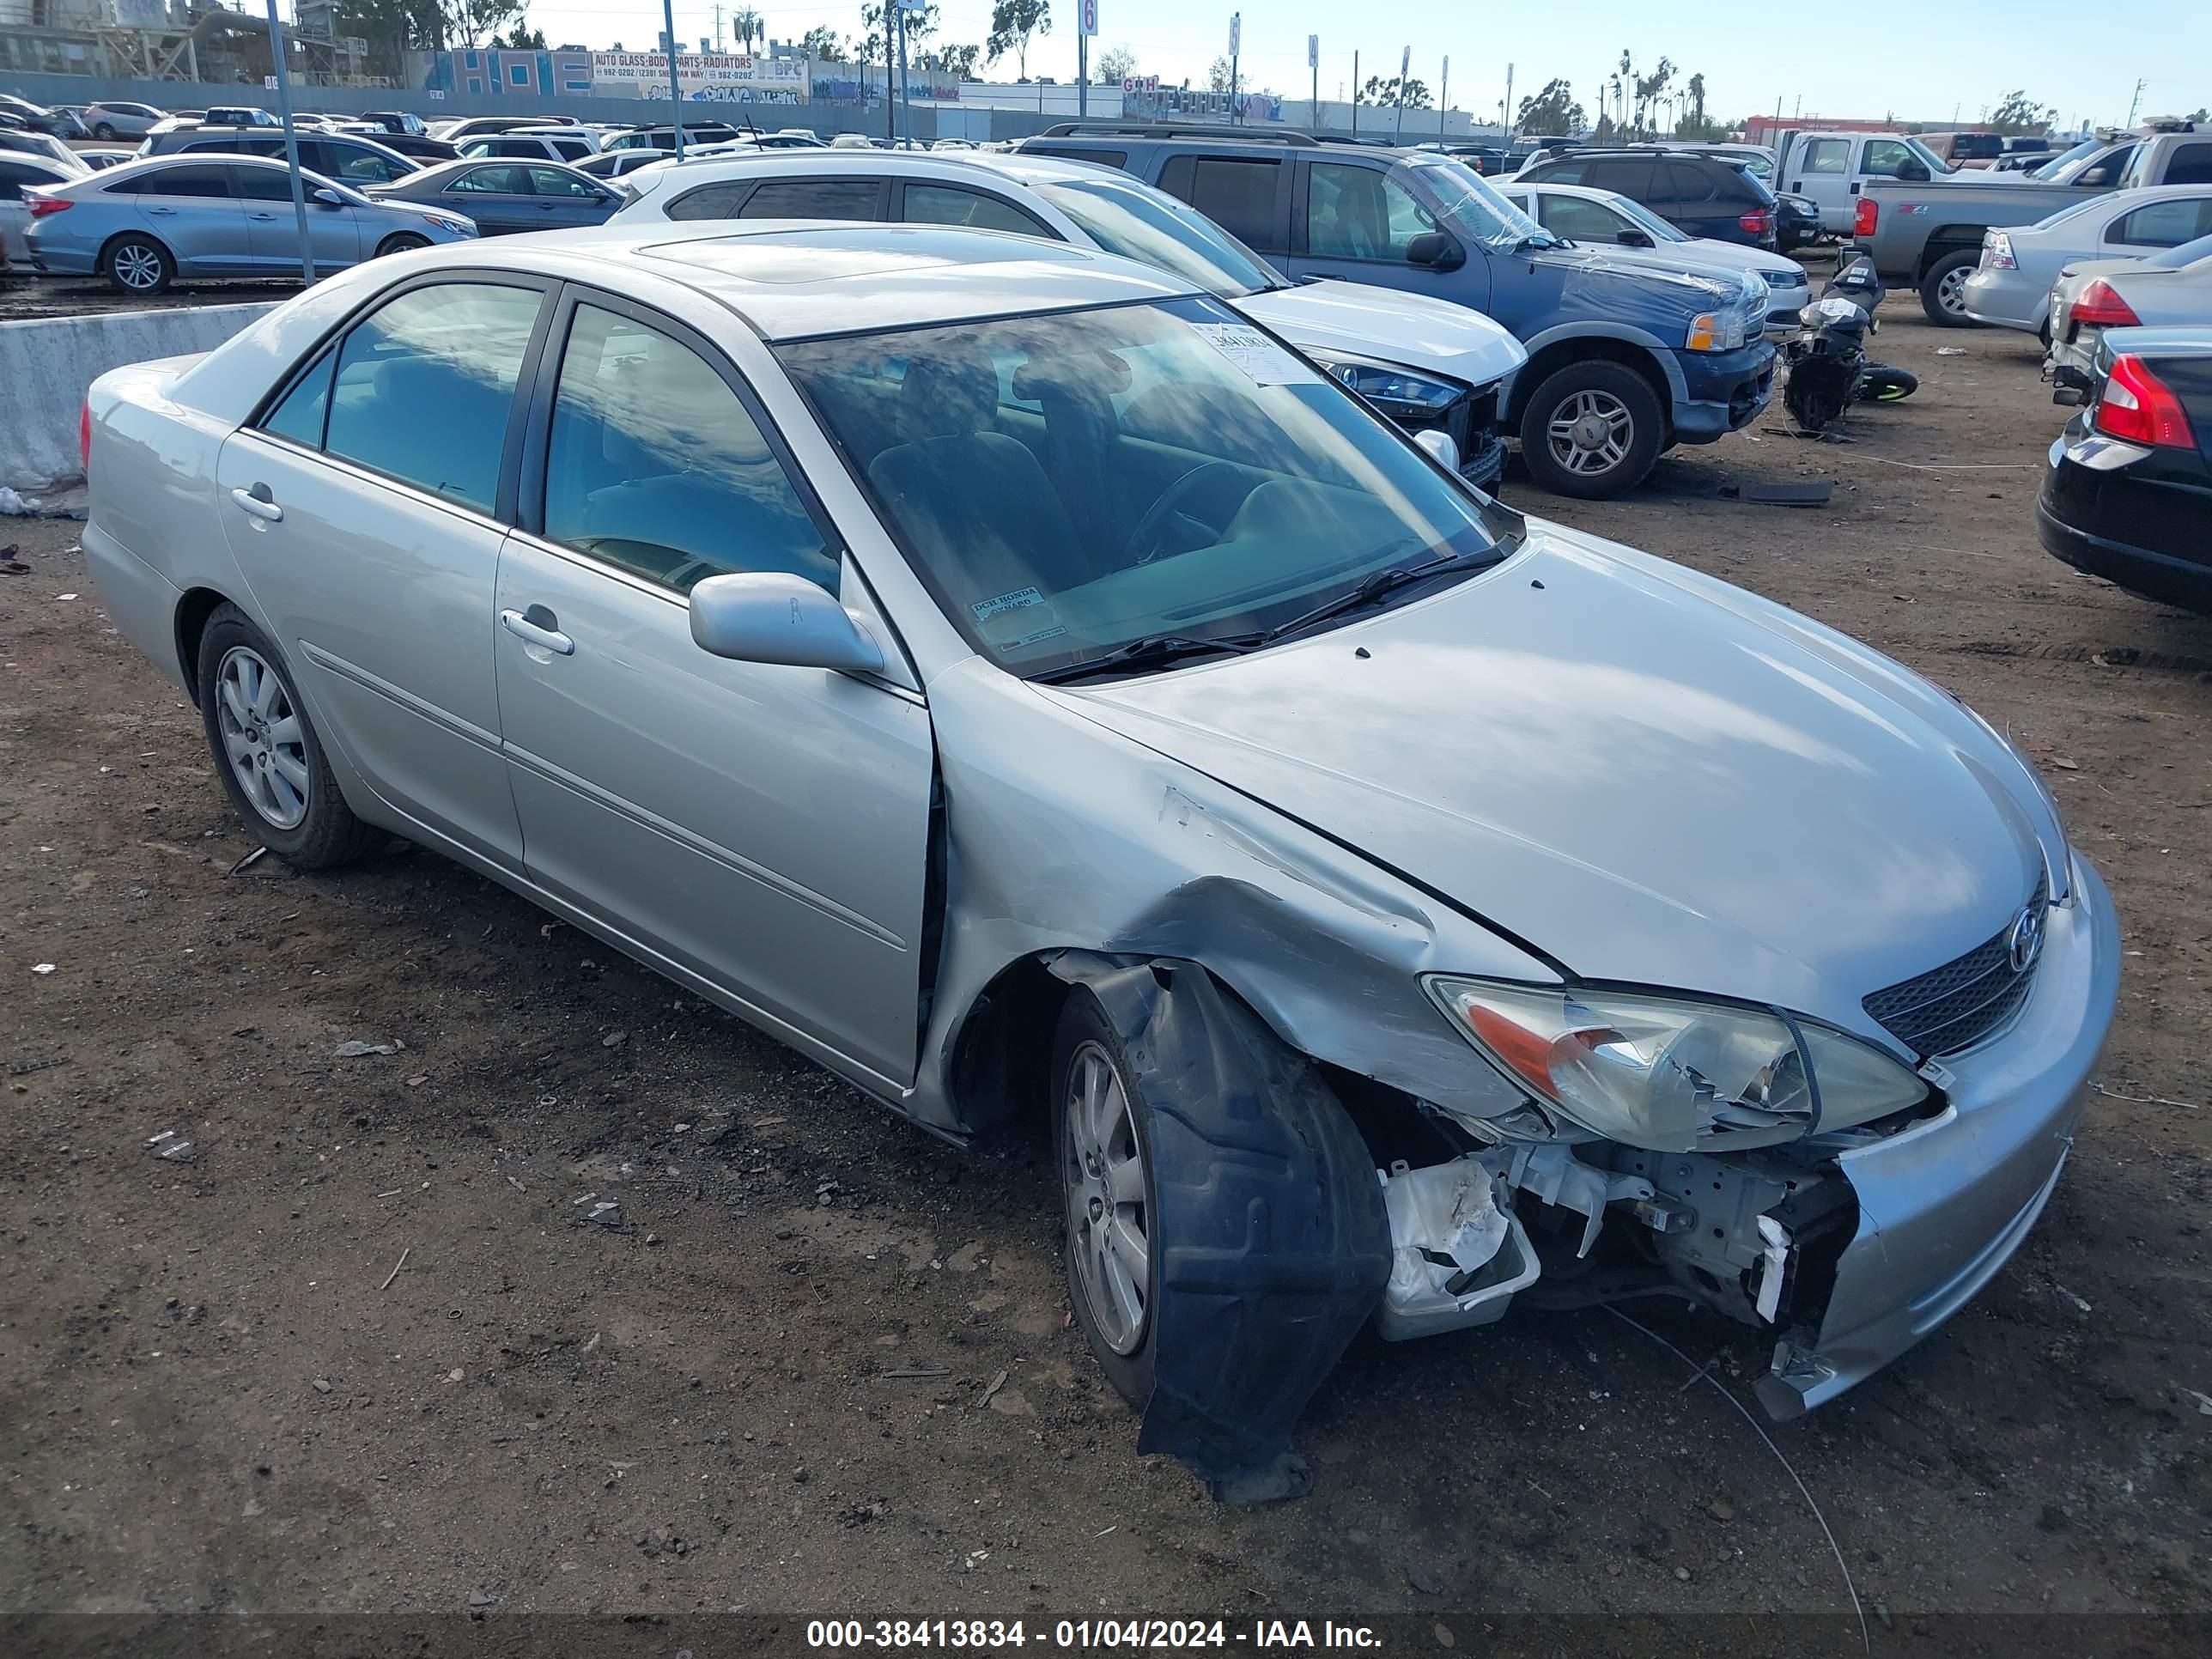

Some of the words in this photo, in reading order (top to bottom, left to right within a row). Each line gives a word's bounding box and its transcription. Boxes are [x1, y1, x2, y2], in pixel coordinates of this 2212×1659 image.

[1085, 0, 1094, 31] 6
[595, 54, 617, 66] AUTO
[775, 62, 803, 76] BPC
[1123, 78, 1133, 92] G
[1146, 78, 1156, 92] H
[974, 599, 998, 612] DCH
[999, 588, 1036, 603] HONDA
